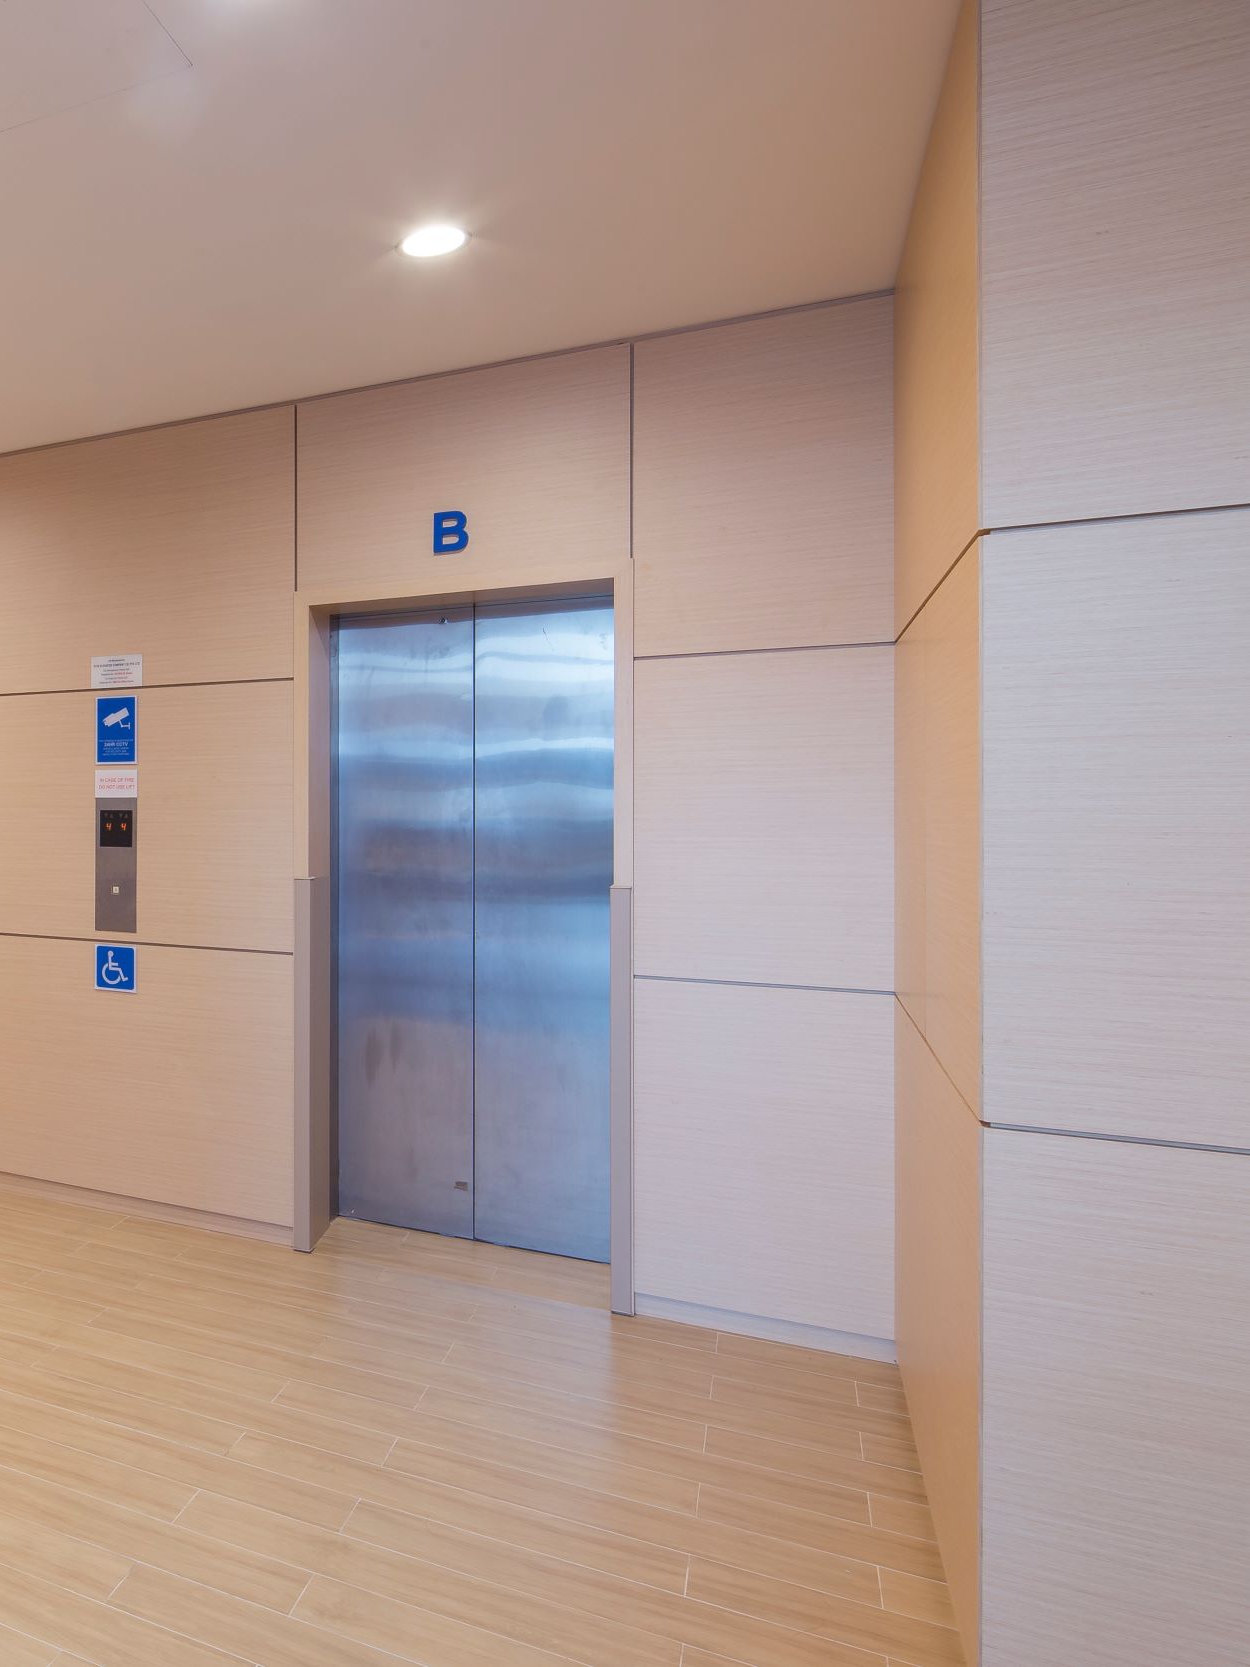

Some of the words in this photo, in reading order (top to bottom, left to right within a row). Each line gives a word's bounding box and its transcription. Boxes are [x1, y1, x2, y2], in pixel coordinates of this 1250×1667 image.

[433, 510, 469, 555] B
[106, 823, 112, 831] 4
[121, 823, 127, 831] 4
